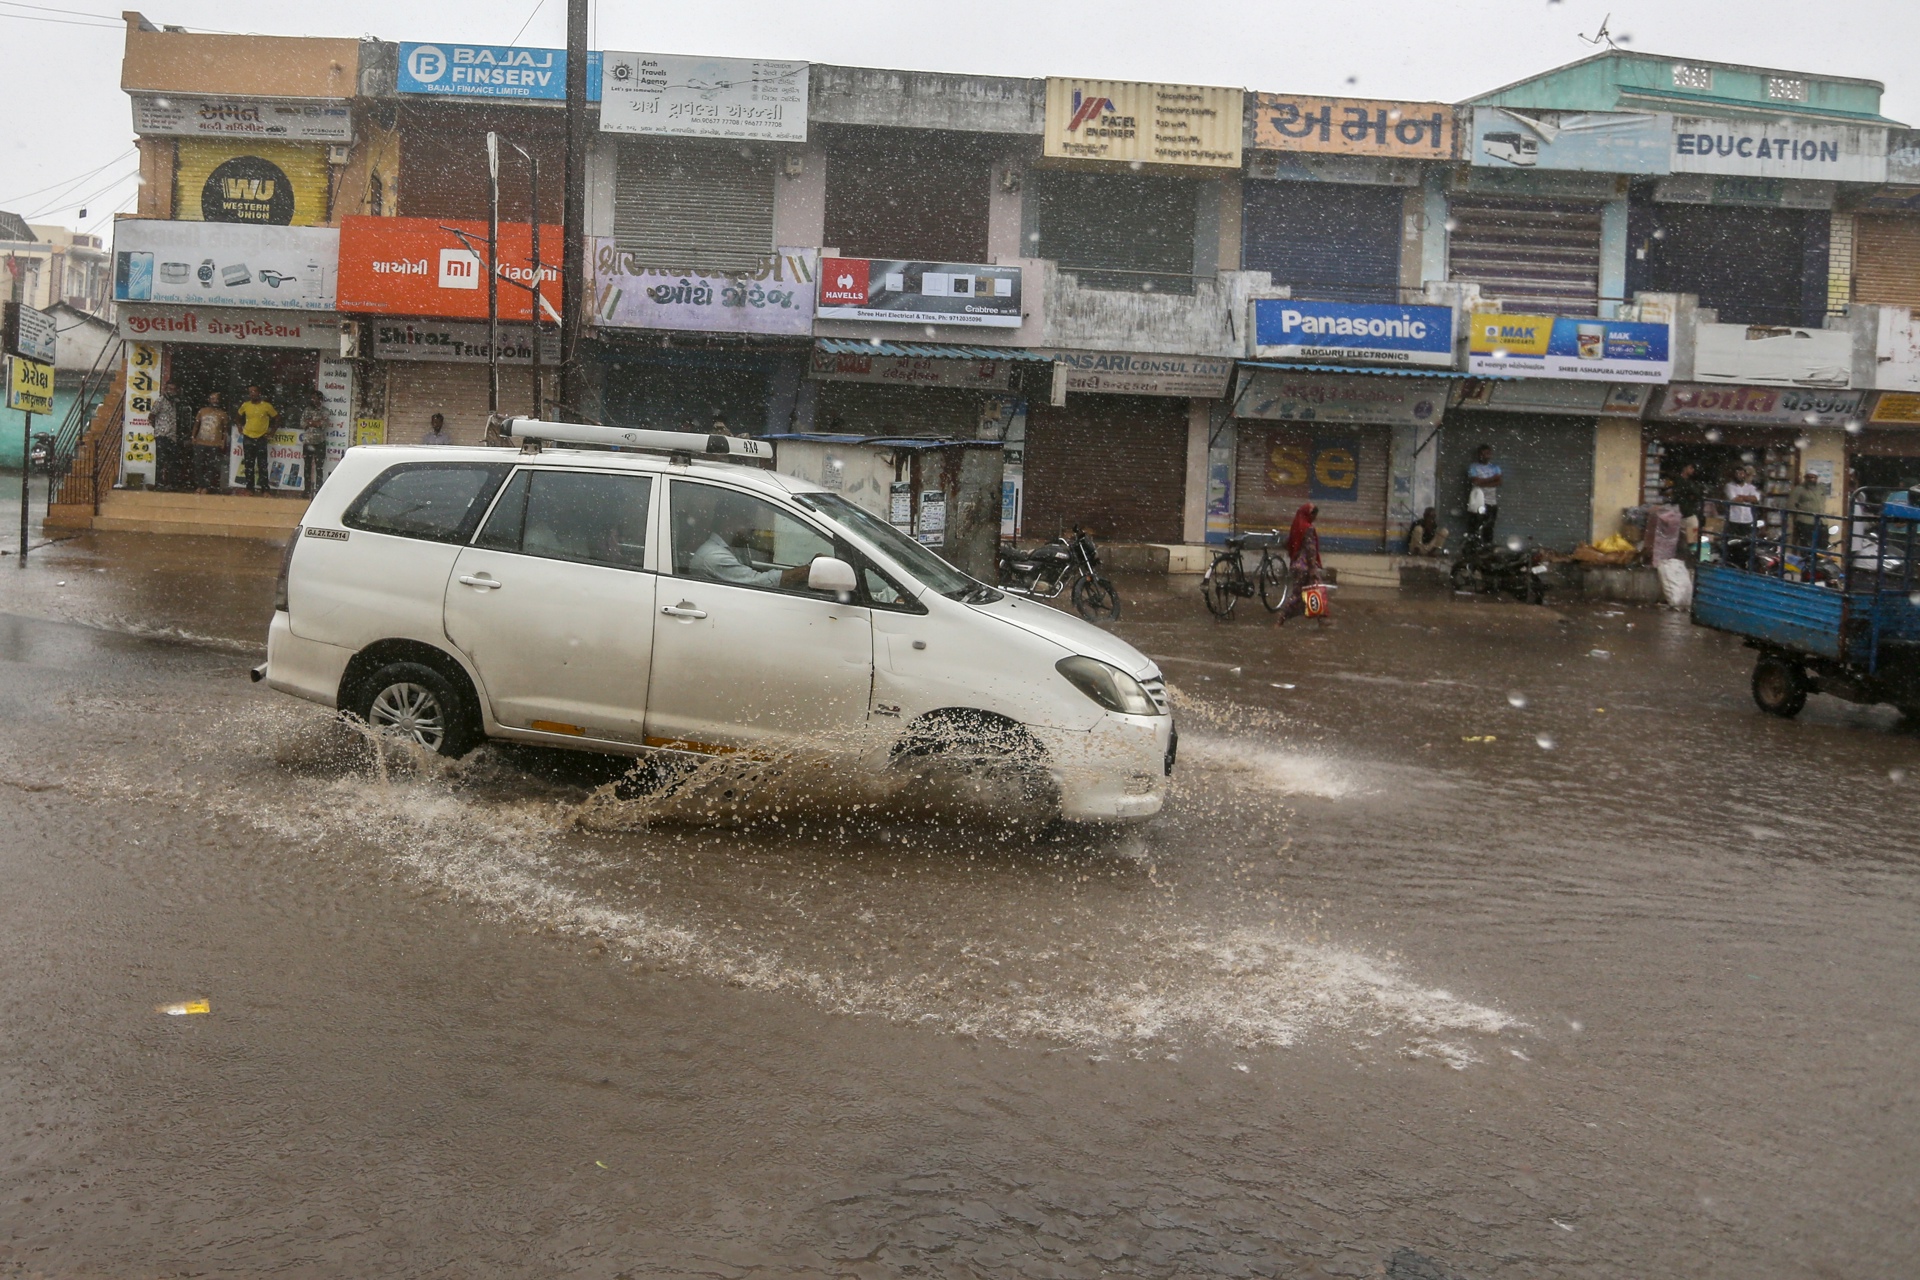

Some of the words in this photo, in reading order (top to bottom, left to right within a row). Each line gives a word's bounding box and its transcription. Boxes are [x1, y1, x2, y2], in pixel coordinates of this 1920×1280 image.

[453, 48, 553, 68] BAJAJ
[452, 66, 552, 87] FINSERV
[641, 68, 667, 76] Travels
[640, 77, 668, 86] Agency
[428, 84, 455, 93] BAJAJ
[457, 86, 494, 95] FINANCE
[496, 87, 530, 96] LIMITED
[1101, 115, 1136, 128] PATEL
[1270, 103, 1442, 148] અમન
[1086, 128, 1135, 138] ENGINEER
[1676, 133, 1838, 162] EDUCATION
[222, 178, 275, 201] WU
[223, 202, 270, 211] WESTERN
[238, 211, 270, 220] UNION
[372, 258, 428, 275] શાઓમી
[825, 291, 864, 300] HAVELLS
[1281, 310, 1427, 339] Panasonic
[379, 325, 450, 346] Shiraz
[1501, 326, 1536, 339] MAK
[1300, 347, 1345, 357] SADGURU
[1347, 350, 1409, 360] ELECTRONICS
[1558, 365, 1577, 373] SHREE
[1580, 366, 1614, 375] ASHAPURA
[1616, 368, 1662, 377] AUTOMOBILES
[743, 440, 759, 454] 4X4
